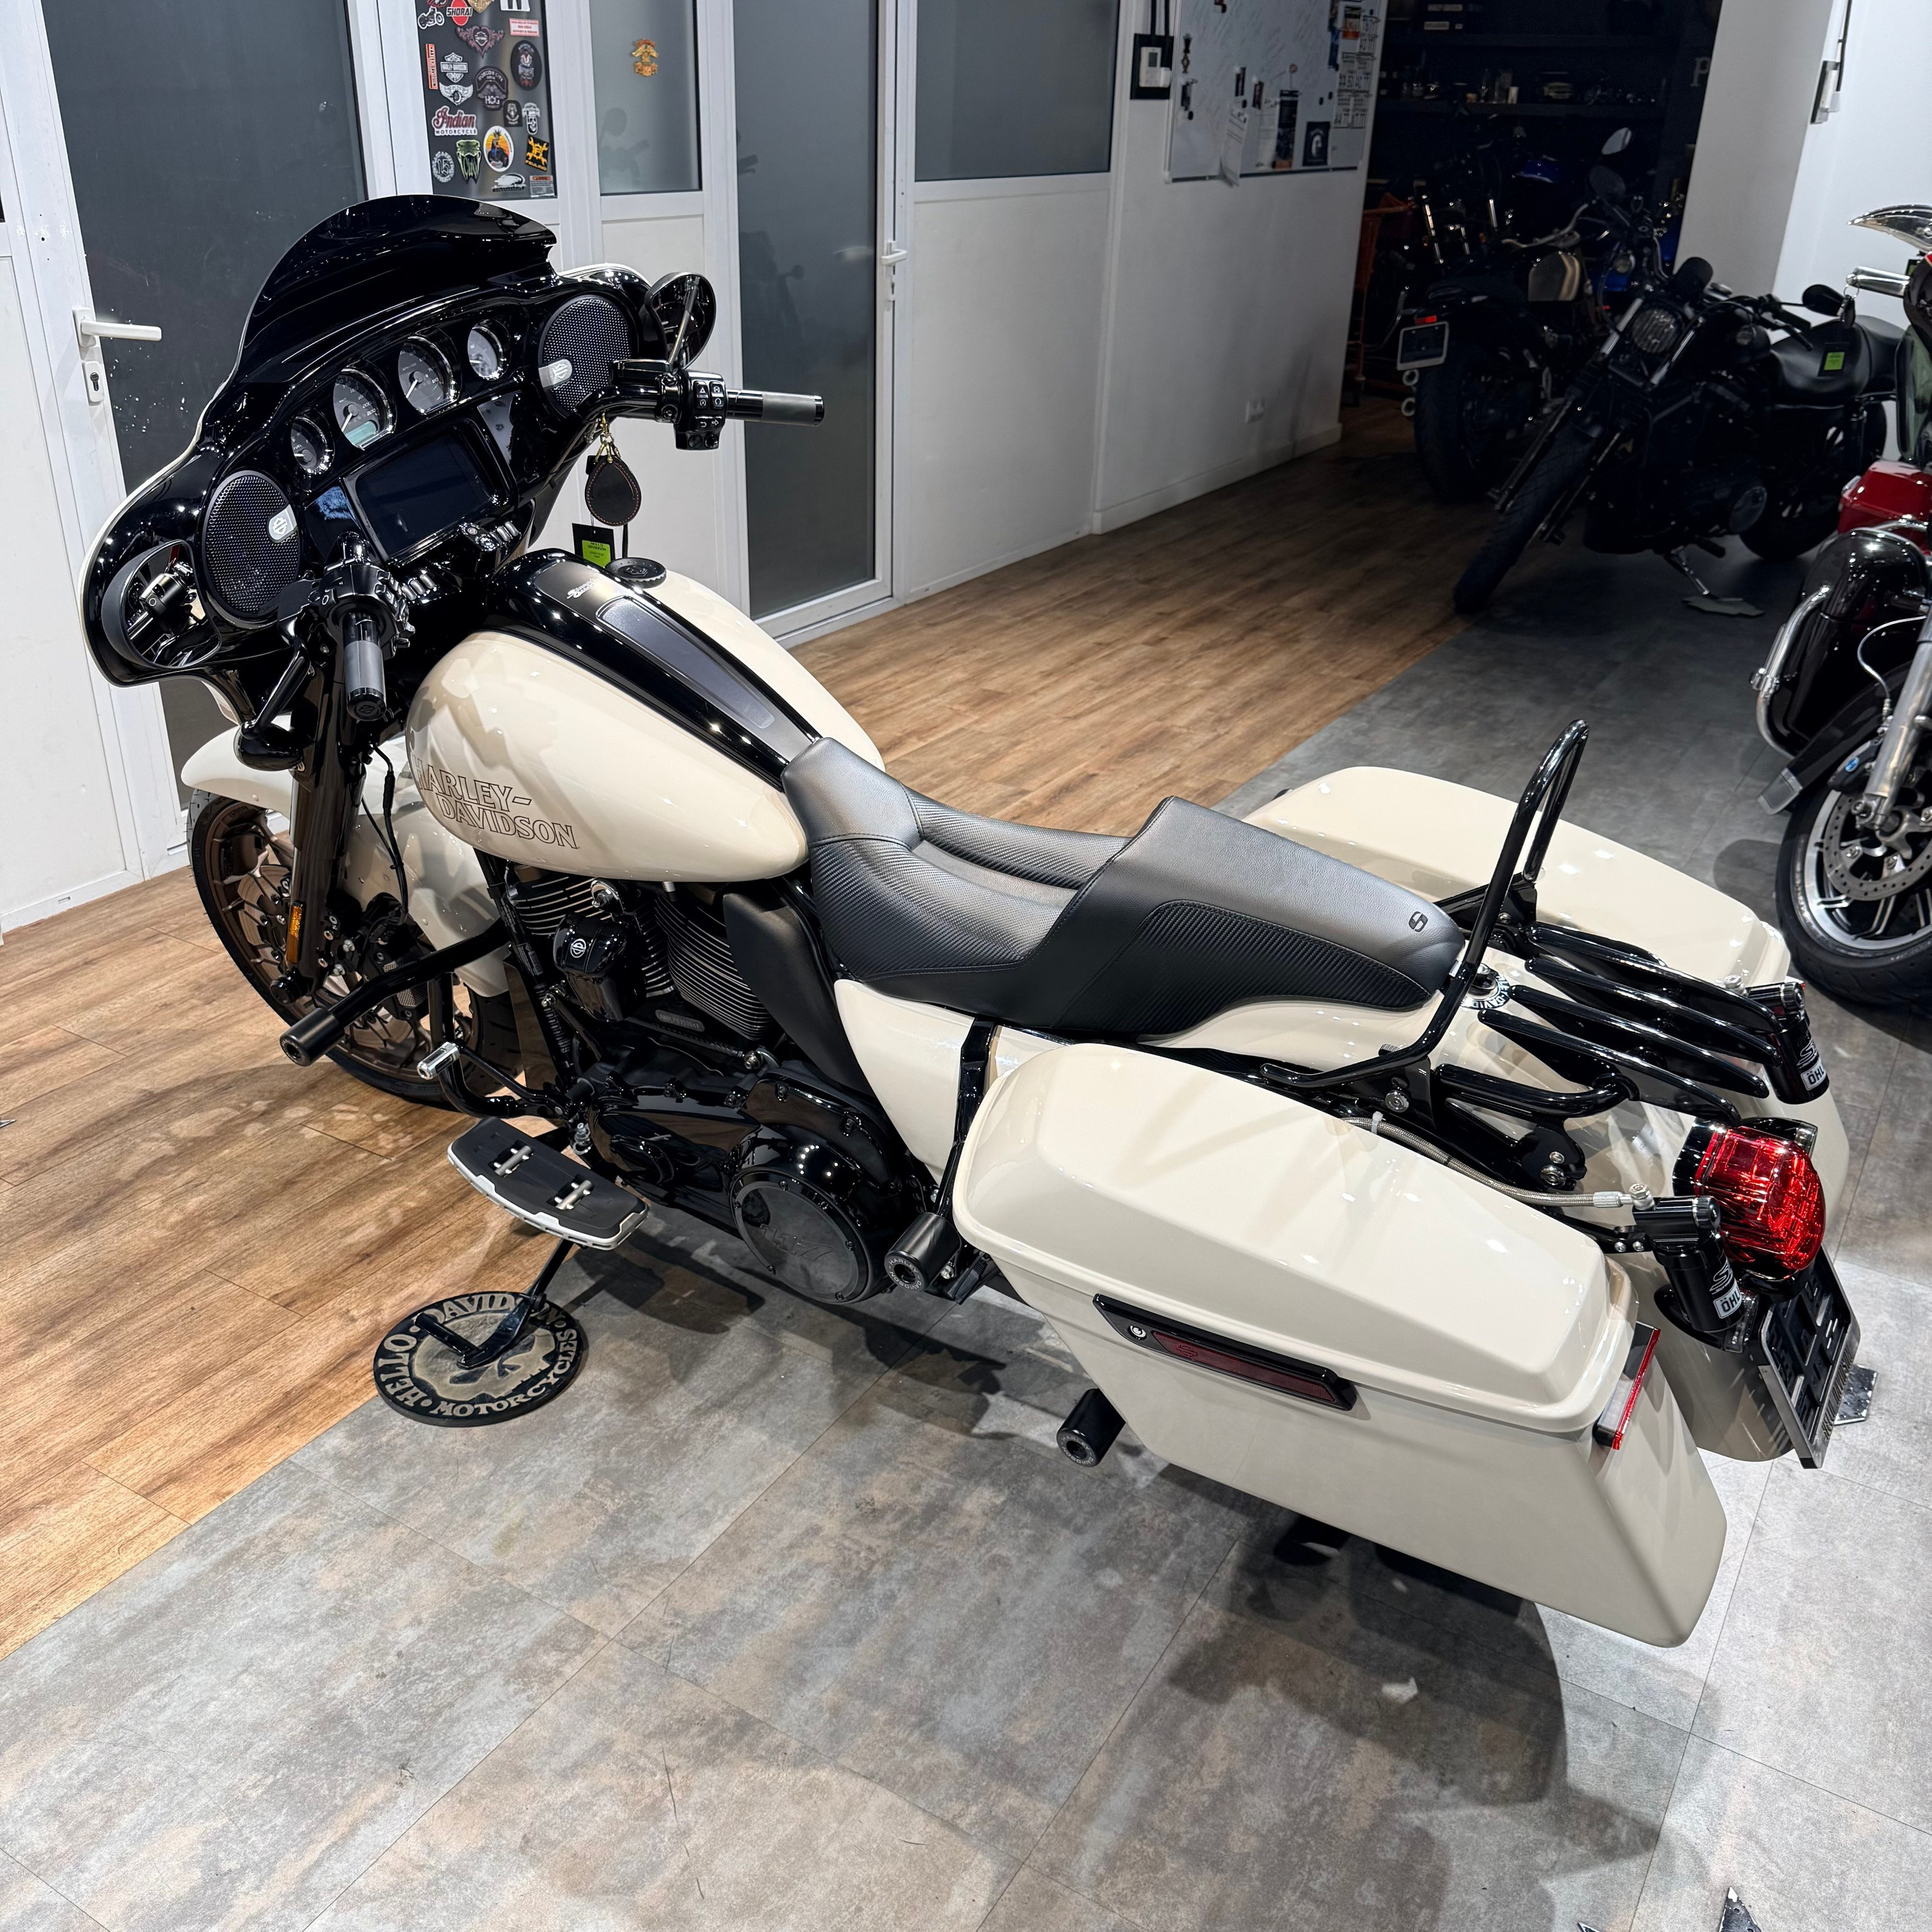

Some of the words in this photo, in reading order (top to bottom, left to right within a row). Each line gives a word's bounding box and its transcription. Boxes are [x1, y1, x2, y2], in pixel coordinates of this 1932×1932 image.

[447, 8, 472, 17] SHORAI
[485, 95, 500, 104] HOG
[433, 106, 475, 129] Indian
[412, 755, 532, 812] HARLEY-
[436, 792, 579, 850] DAVIDSON
[888, 1258, 918, 1273] HARLEY
[889, 1271, 922, 1290] DAVIDSON
[378, 1334, 427, 1407] HELLO
[429, 1328, 578, 1417] MOTORCYCLES
[1061, 1435, 1091, 1451] HARLEY
[1061, 1446, 1094, 1465] DAVIDSON
